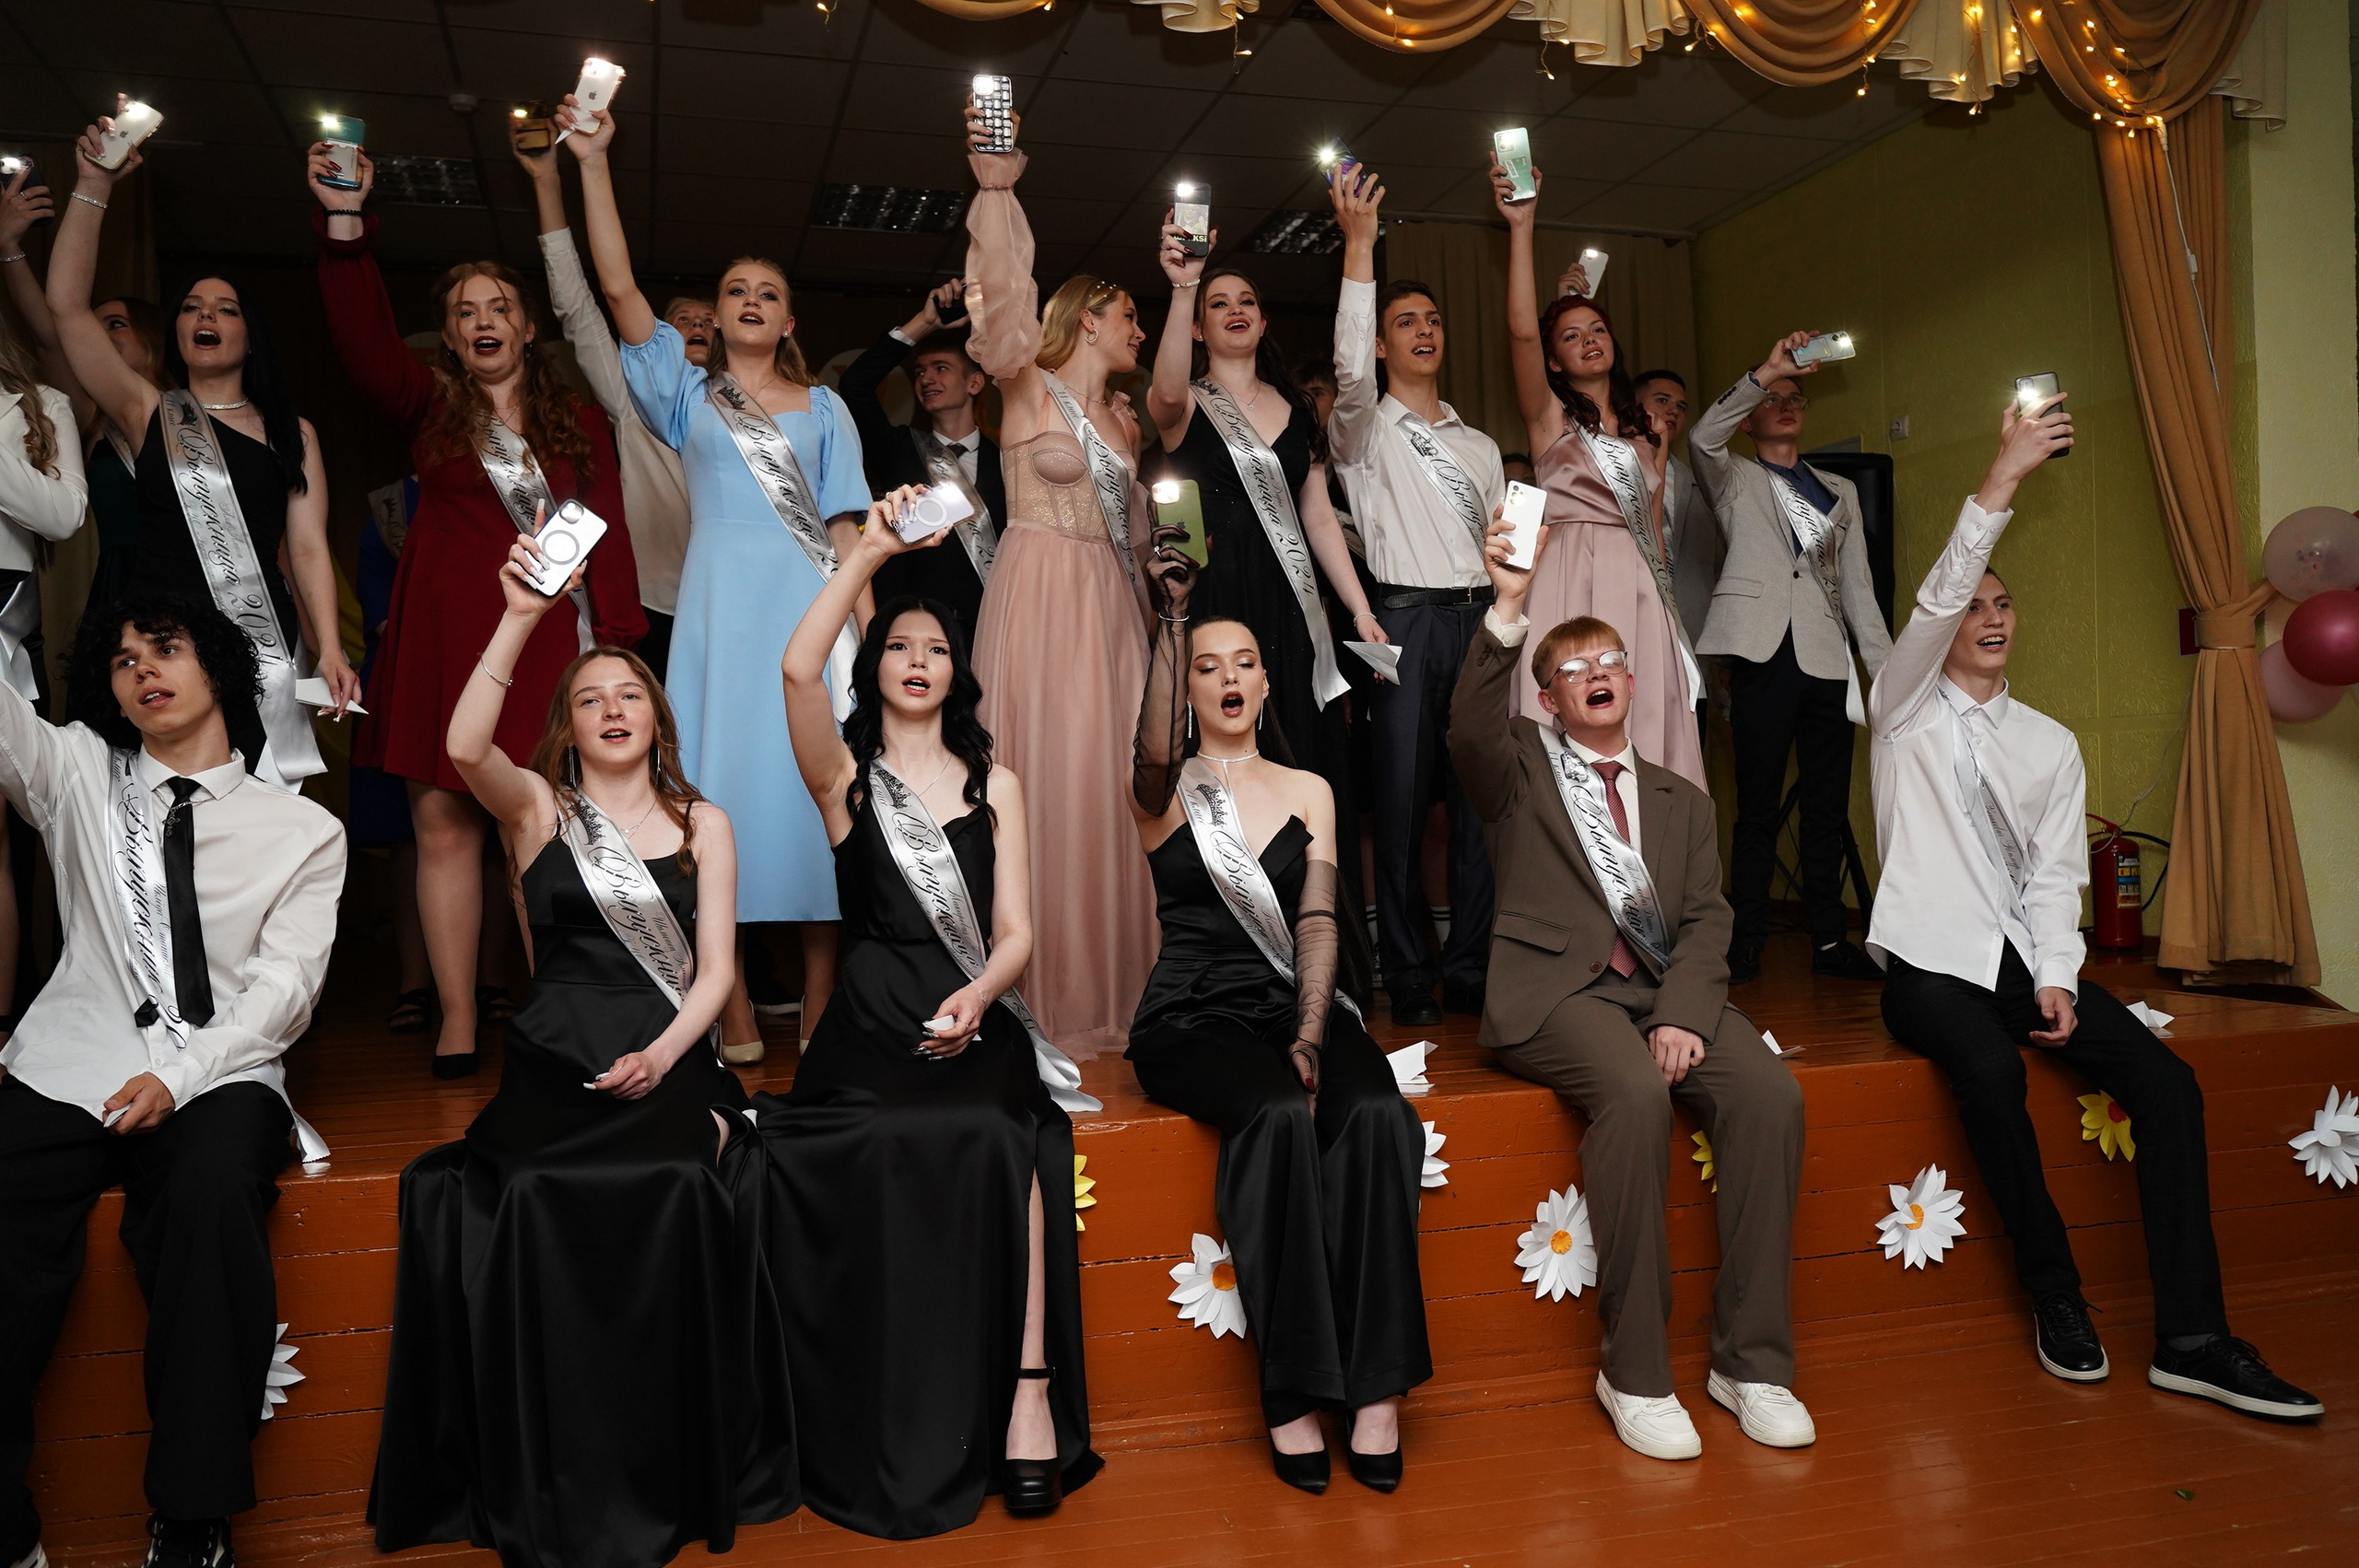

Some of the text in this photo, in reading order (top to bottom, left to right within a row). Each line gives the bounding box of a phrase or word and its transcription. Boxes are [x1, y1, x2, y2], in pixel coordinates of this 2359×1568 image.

[176, 427, 242, 587] Выпускница
[733, 411, 821, 547] Выпускница
[1210, 396, 1284, 528] Выпускница
[1276, 532, 1316, 597] 2024
[1591, 436, 1652, 548] Выпускница
[113, 783, 165, 995] Выпускник
[891, 812, 980, 967] Выпускница
[1568, 784, 1648, 941] Выпускник
